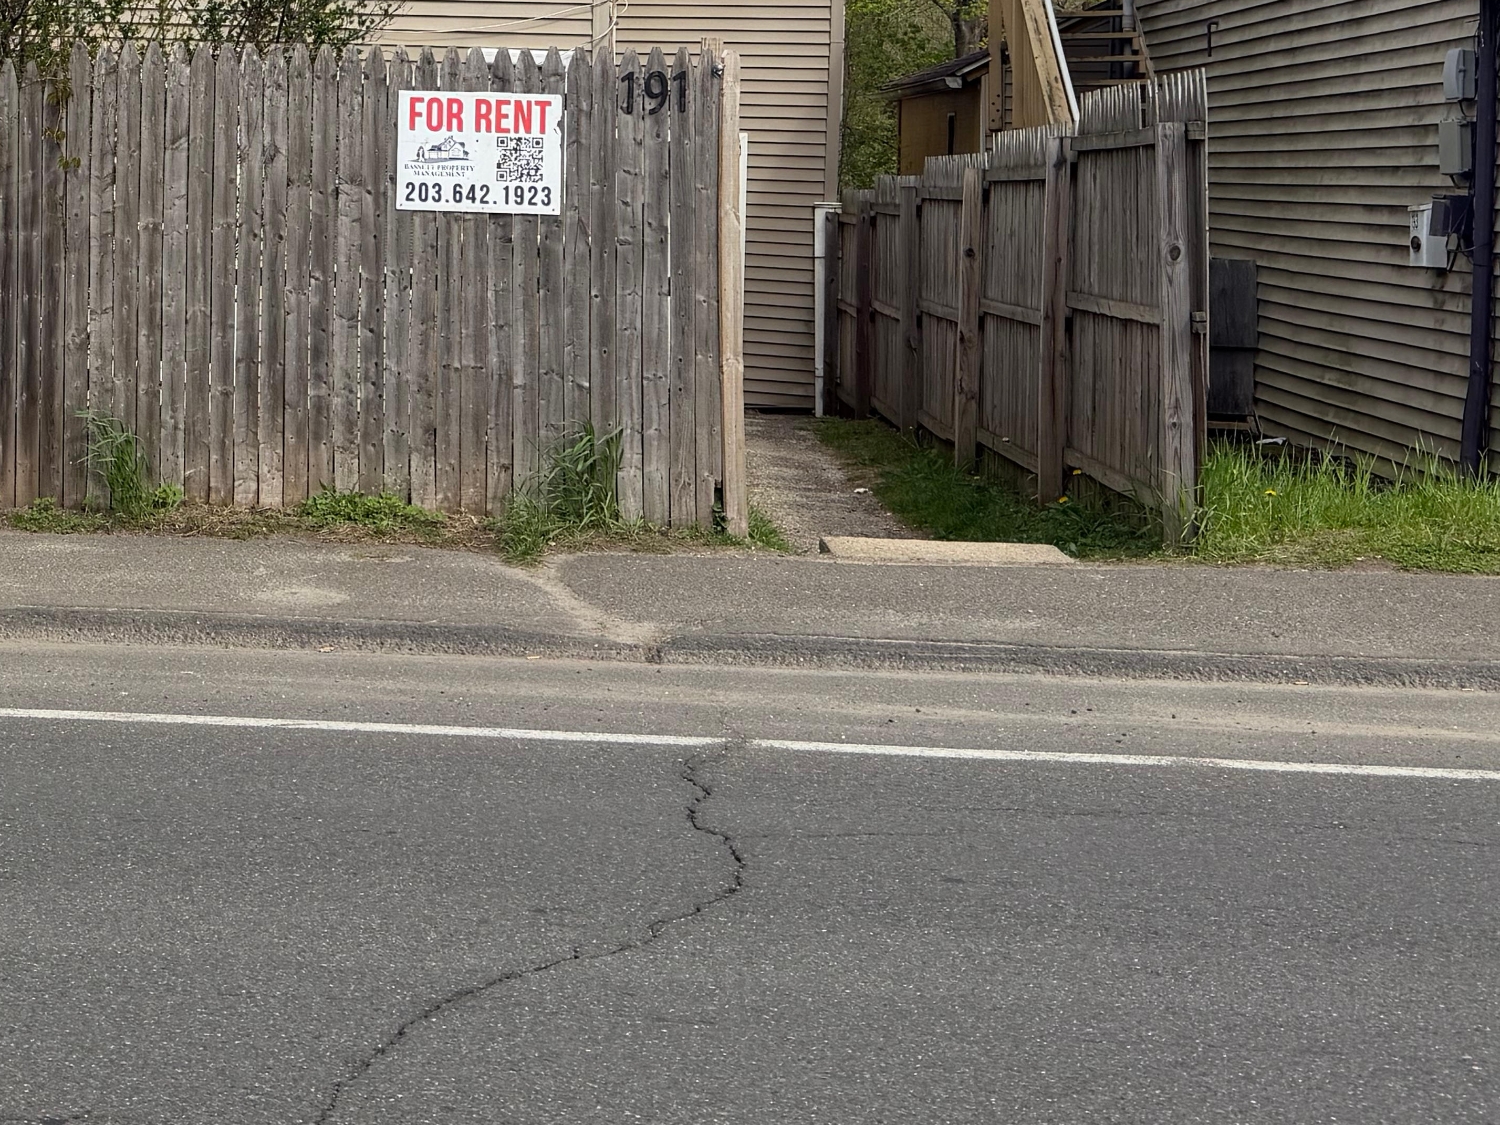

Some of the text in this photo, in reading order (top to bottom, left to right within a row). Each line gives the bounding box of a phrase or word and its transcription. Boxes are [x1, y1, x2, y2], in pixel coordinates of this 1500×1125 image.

[620, 70, 686, 115] 191
[409, 97, 552, 134] FOR RENT
[405, 182, 551, 206] 203.642.1923
